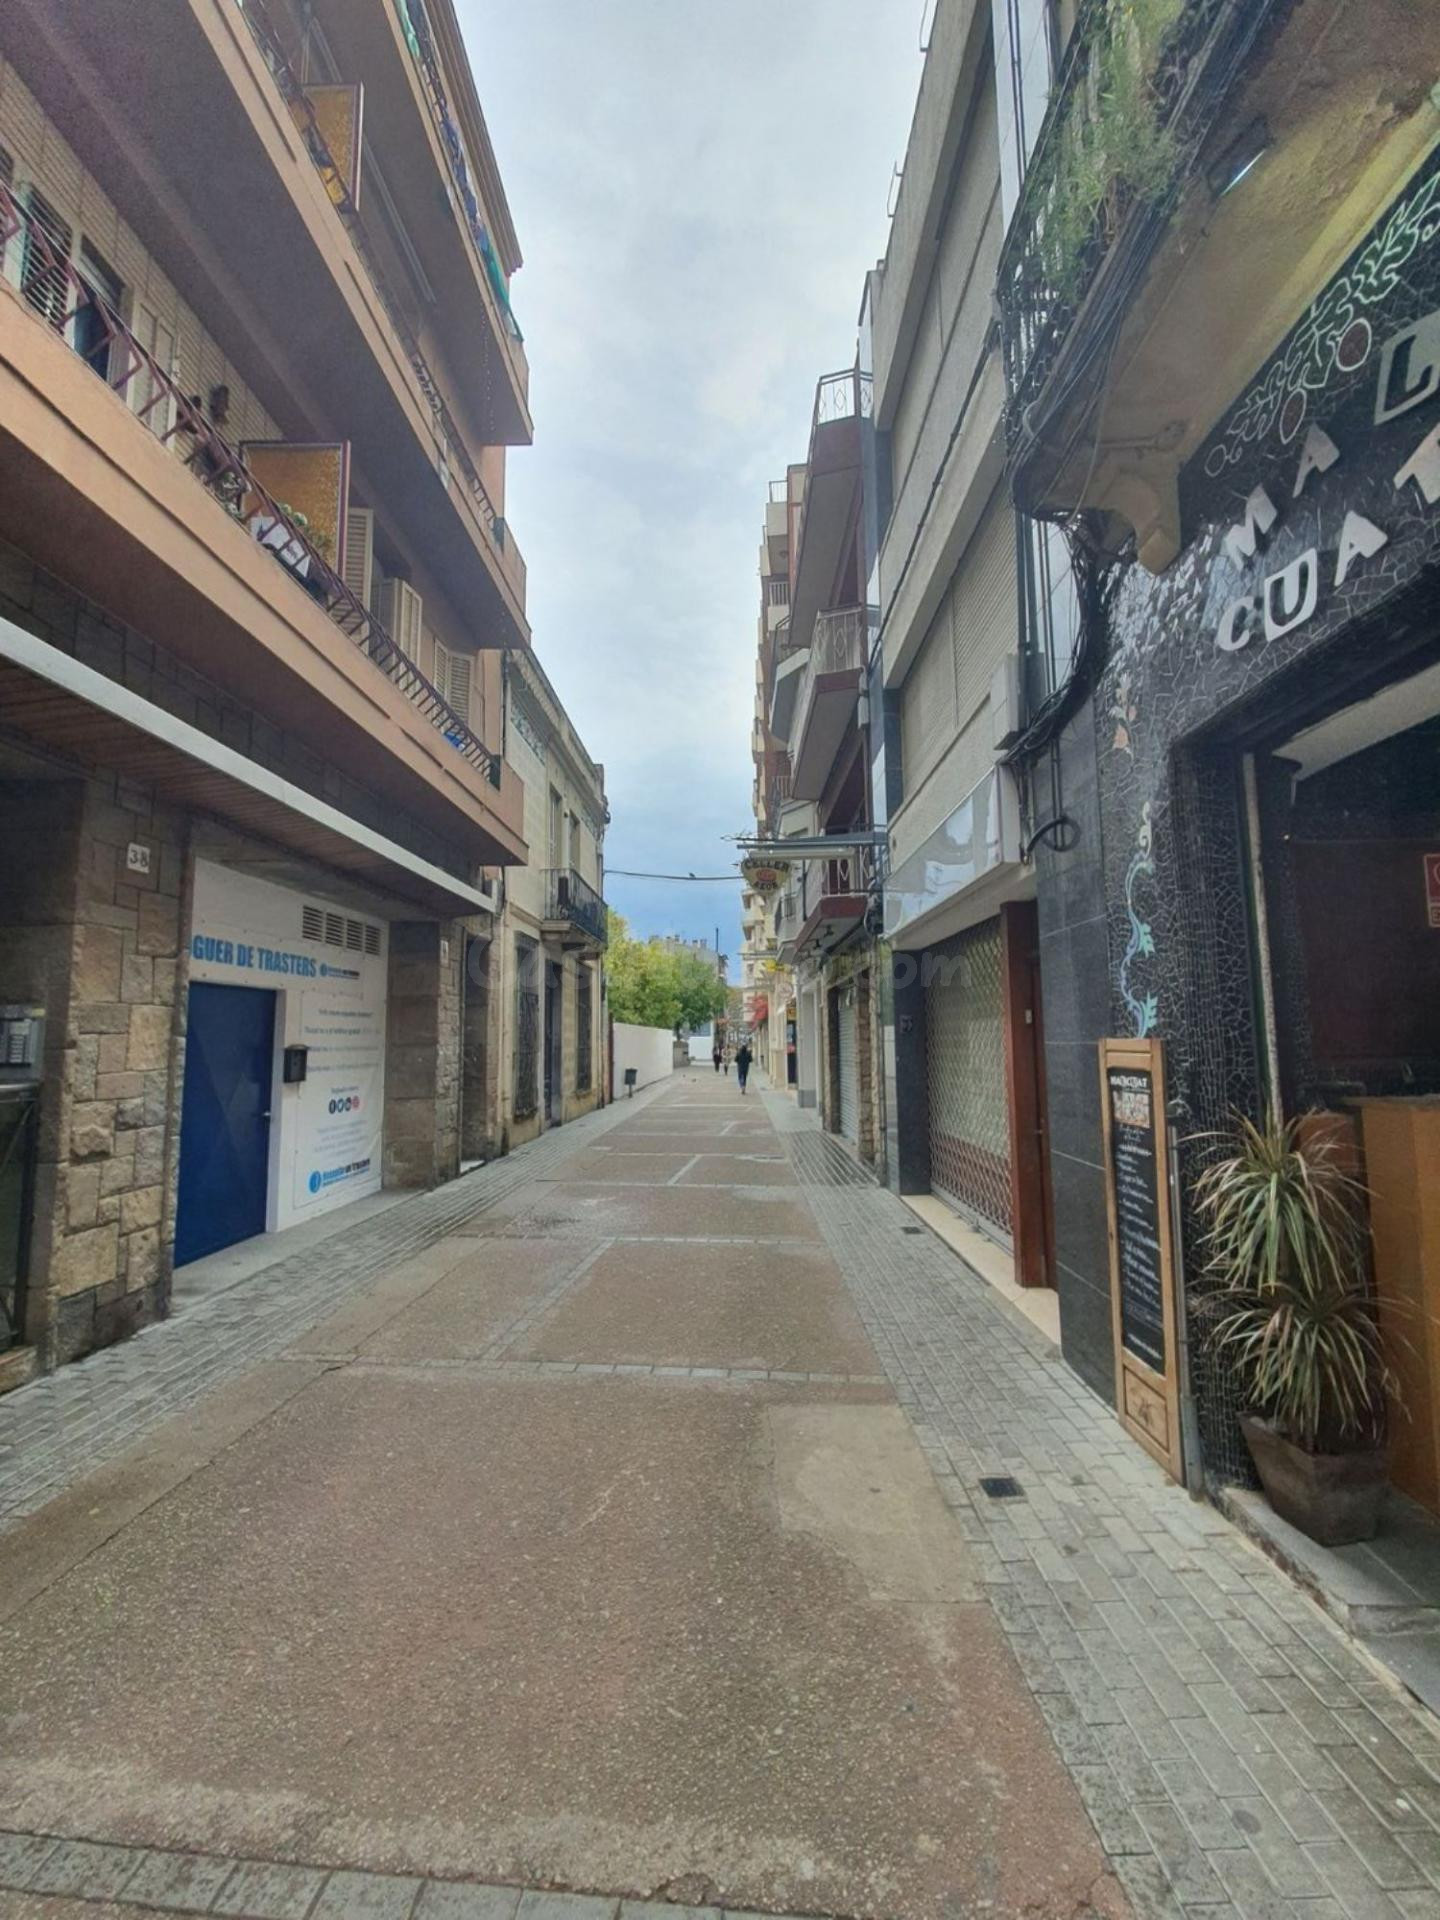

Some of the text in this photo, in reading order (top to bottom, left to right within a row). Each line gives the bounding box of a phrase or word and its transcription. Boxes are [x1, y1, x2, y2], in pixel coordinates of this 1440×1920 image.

[129, 848, 149, 868] 38
[189, 935, 234, 965] GUER
[237, 944, 254, 968] DE
[256, 947, 318, 978] TRASTERS
